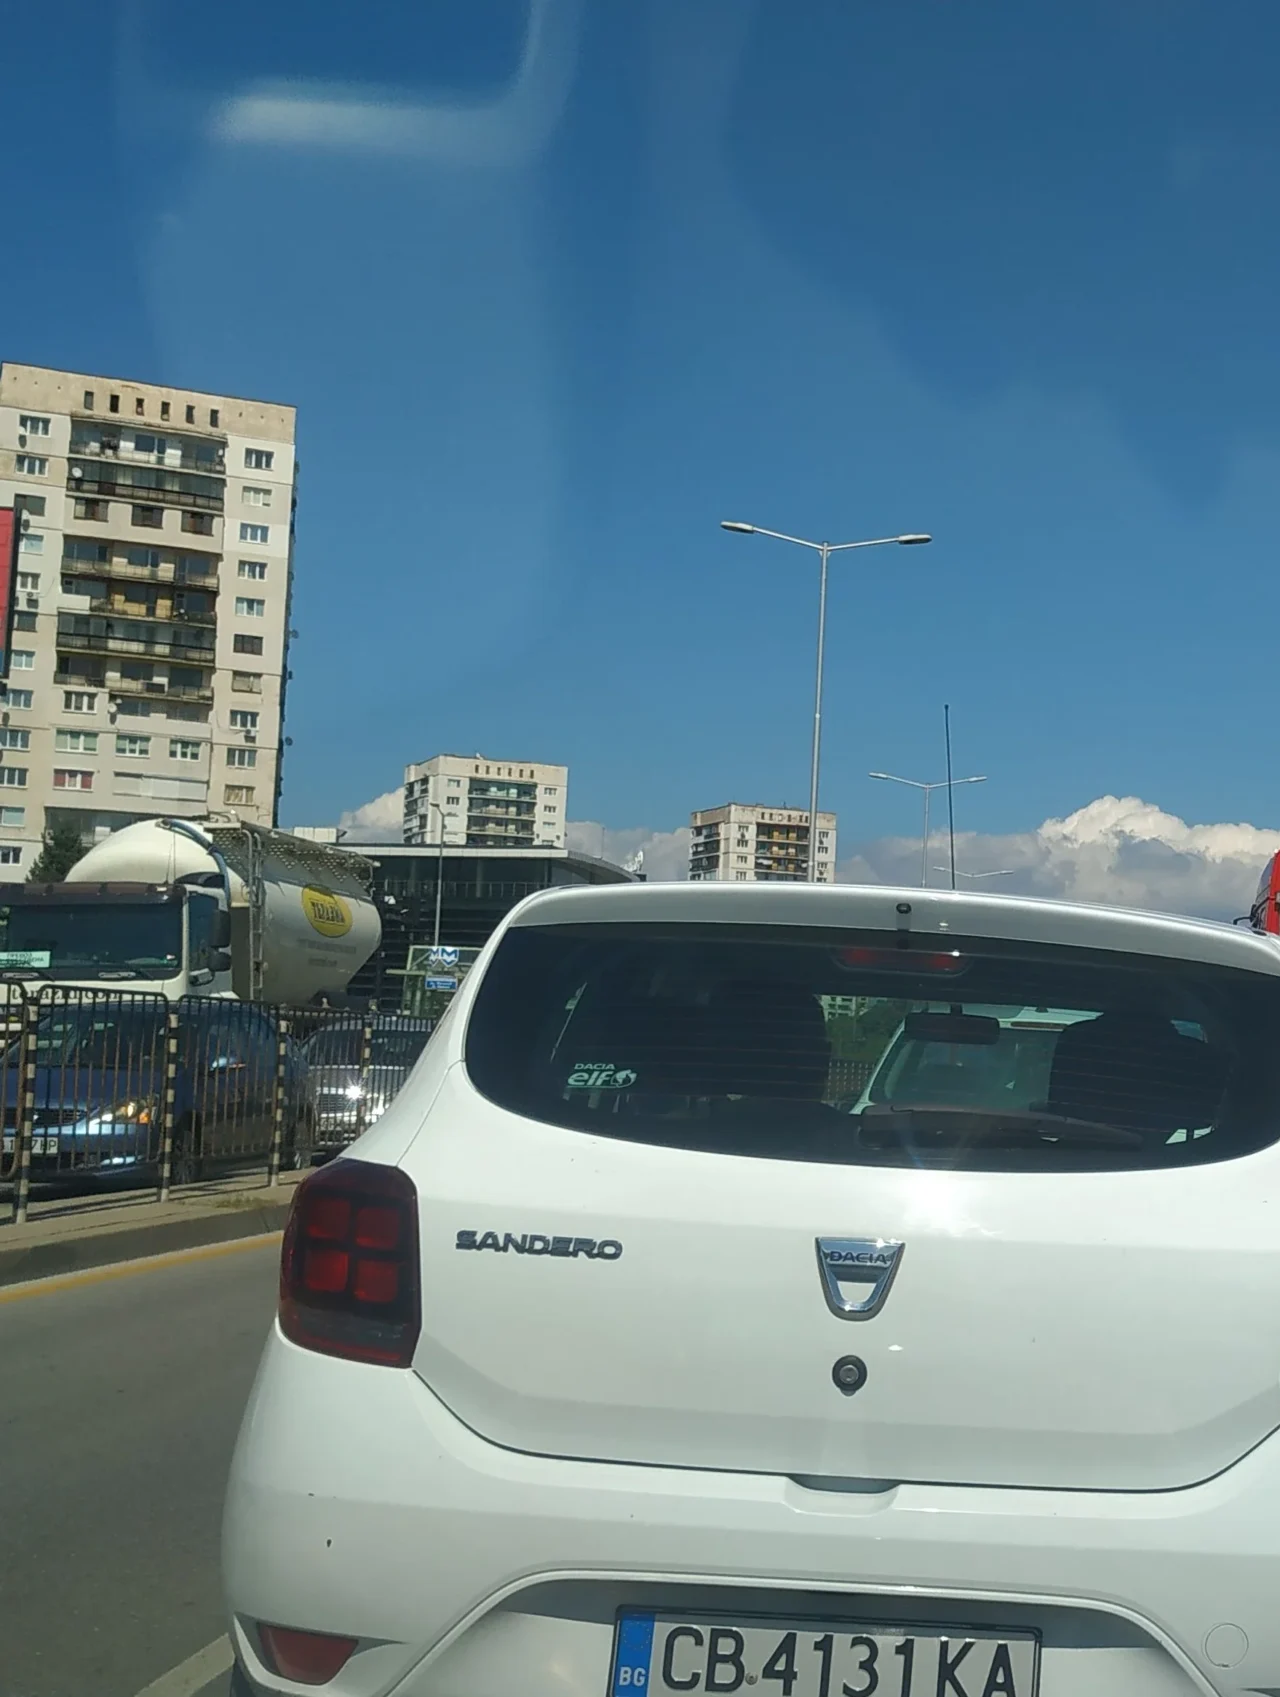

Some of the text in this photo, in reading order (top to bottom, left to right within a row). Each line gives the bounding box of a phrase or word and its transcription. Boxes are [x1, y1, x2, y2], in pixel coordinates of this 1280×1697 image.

[567, 1071, 614, 1086] elf
[455, 1229, 624, 1261] SANDERO
[829, 1250, 888, 1265] DACIA
[761, 1631, 915, 1697] 4131
[618, 1665, 647, 1685] BG
